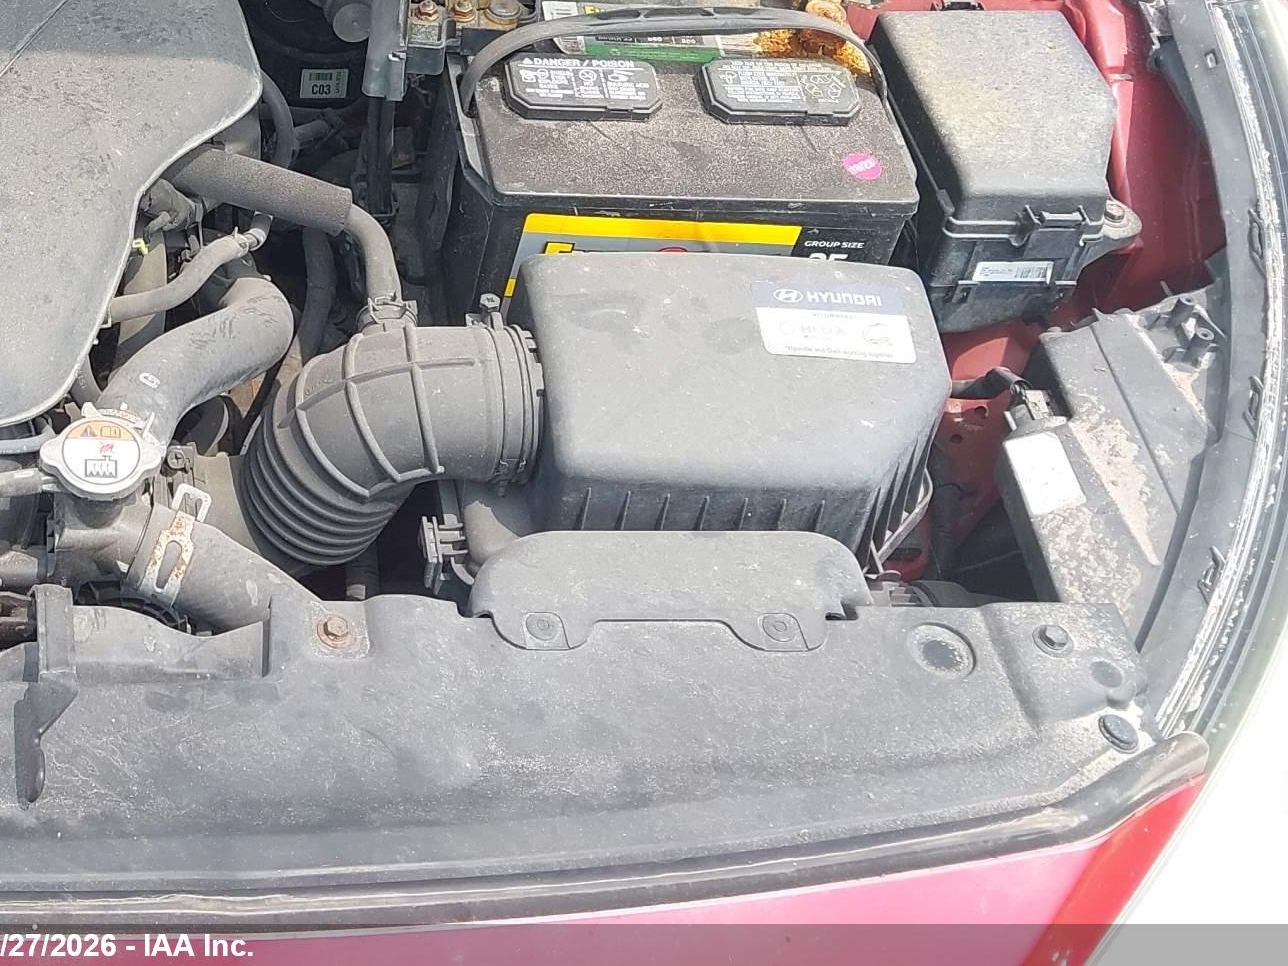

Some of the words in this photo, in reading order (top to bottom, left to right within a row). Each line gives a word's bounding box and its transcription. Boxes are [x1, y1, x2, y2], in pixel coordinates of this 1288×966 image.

[534, 57, 581, 67] DANGER
[592, 60, 635, 68] POISON
[312, 84, 331, 95] C03
[804, 240, 841, 248] GROUP
[841, 241, 865, 249] SIZE
[807, 291, 882, 307] HYUNDAI
